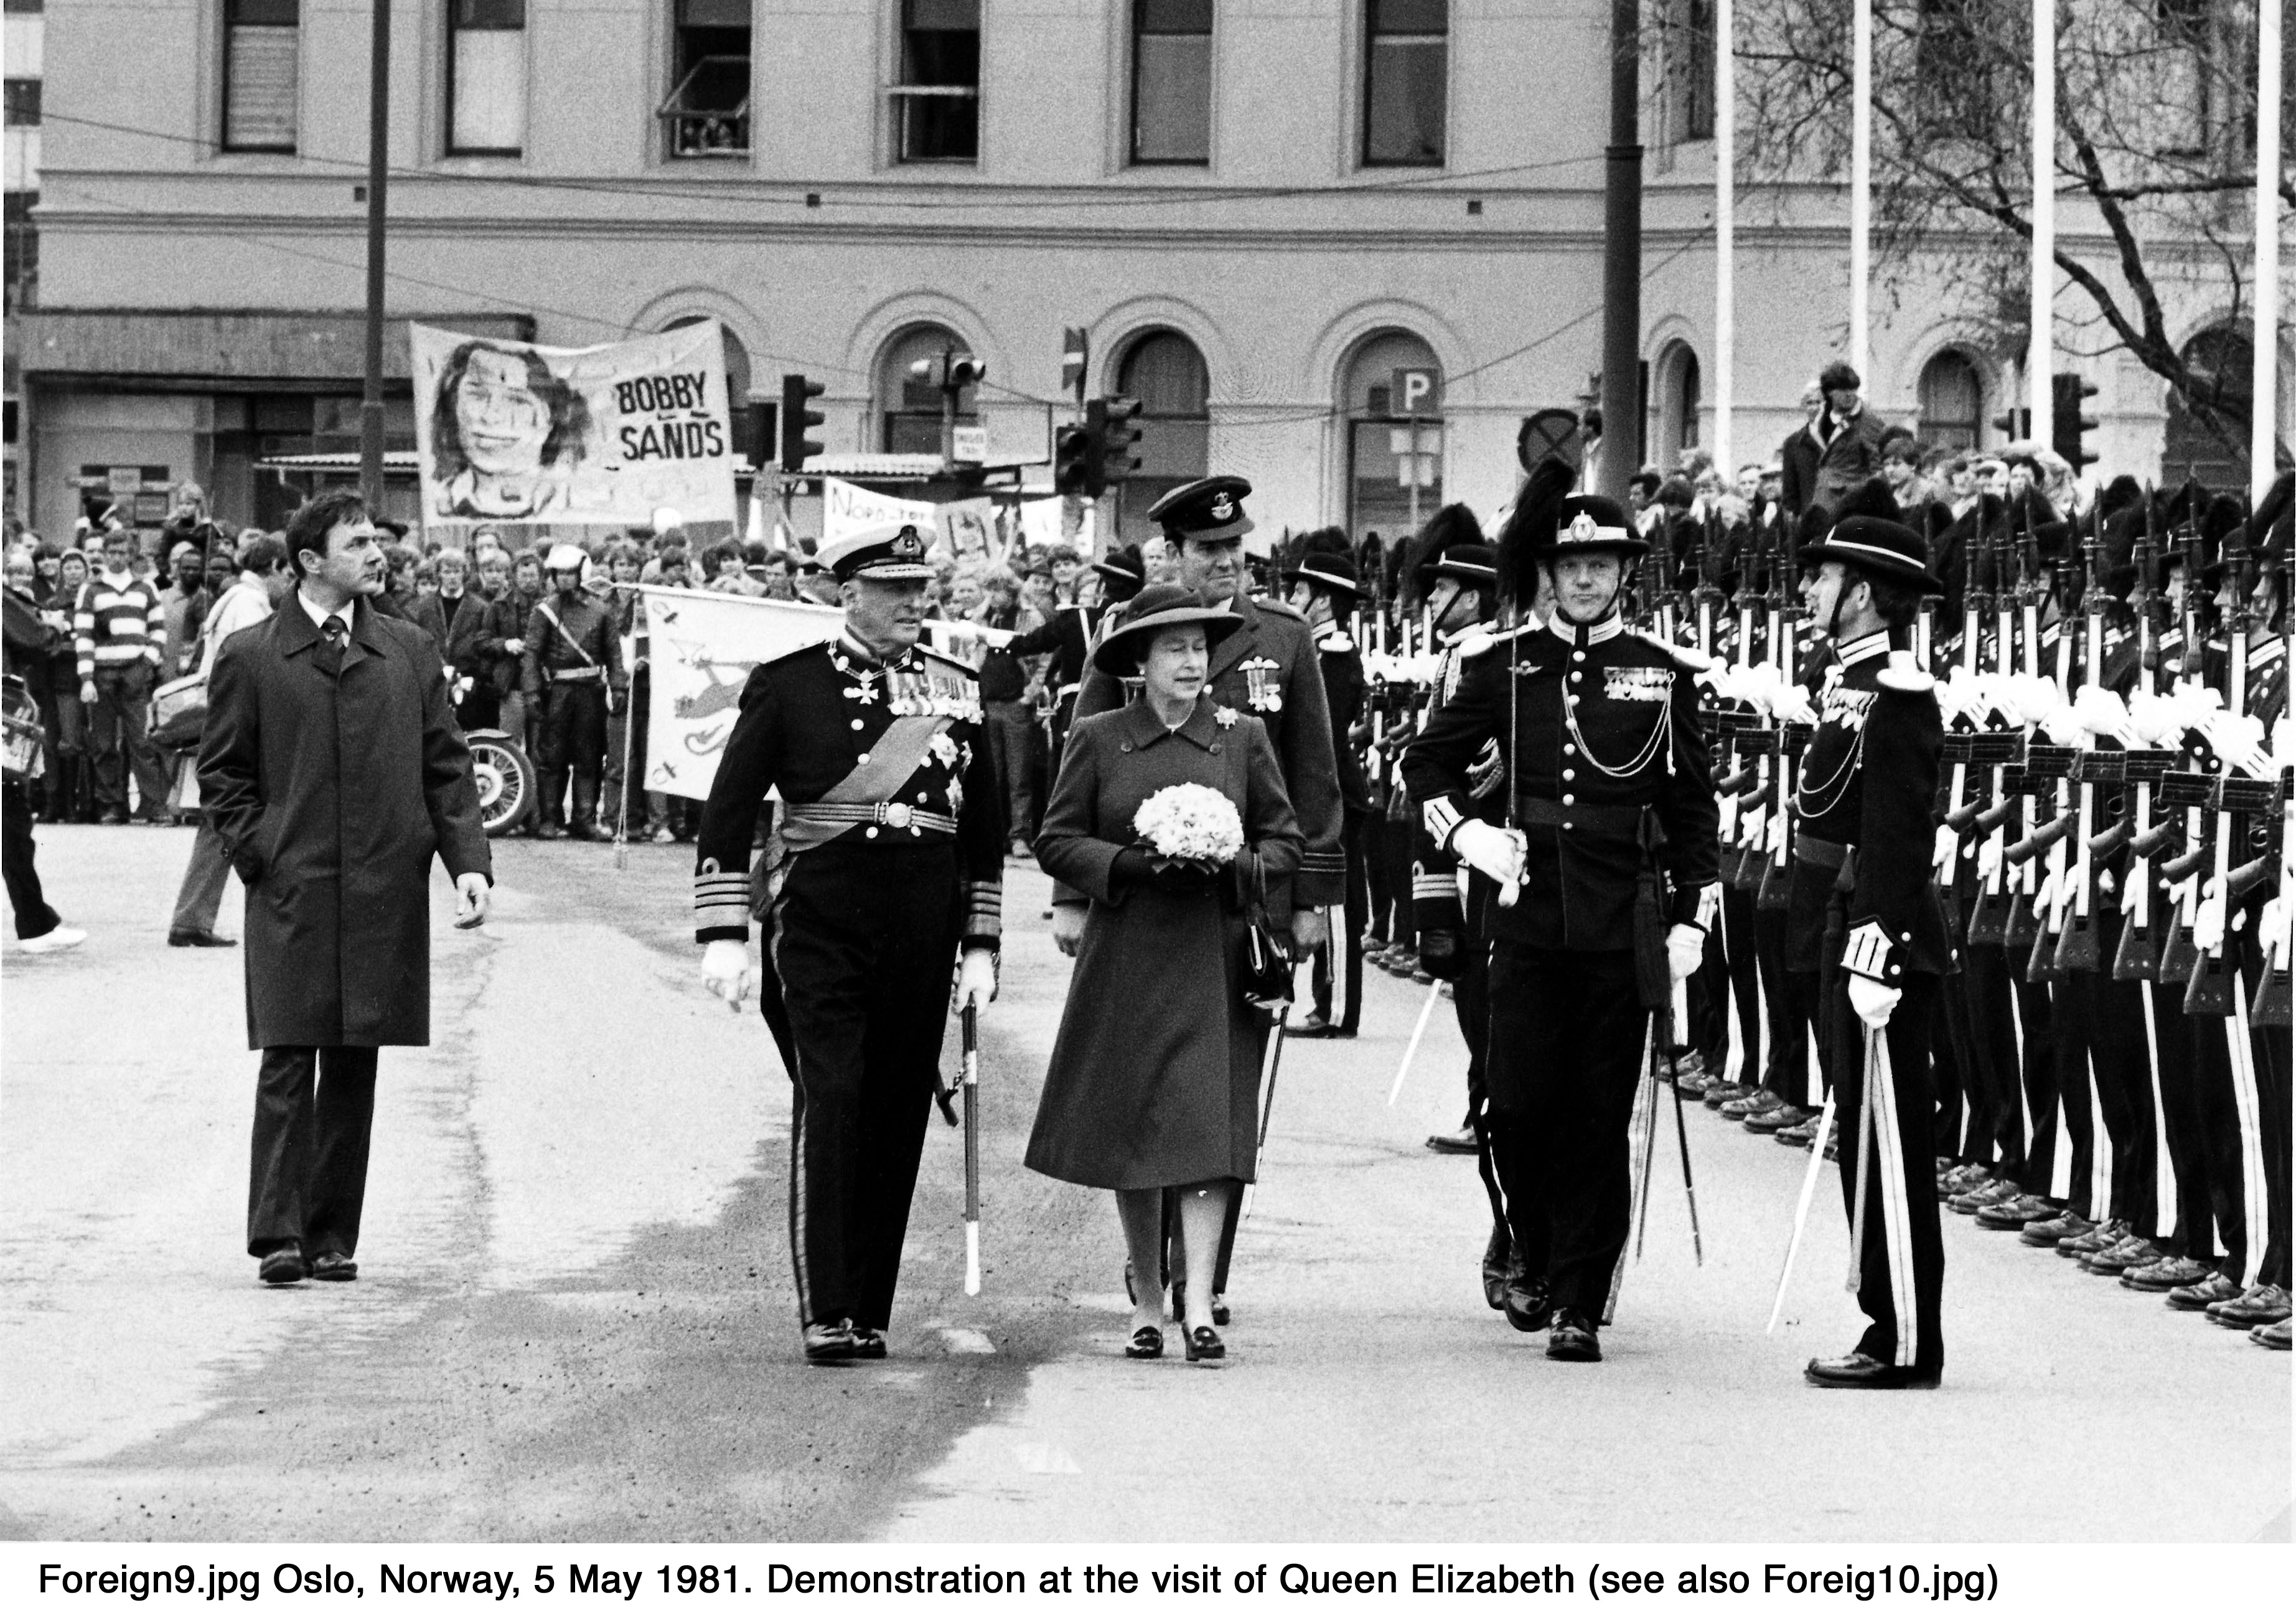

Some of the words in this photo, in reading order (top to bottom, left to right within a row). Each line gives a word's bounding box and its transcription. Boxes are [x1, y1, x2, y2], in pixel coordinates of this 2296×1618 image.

[615, 370, 705, 414] BOBBY
[1405, 373, 1430, 411] P
[621, 420, 723, 461] SANDS
